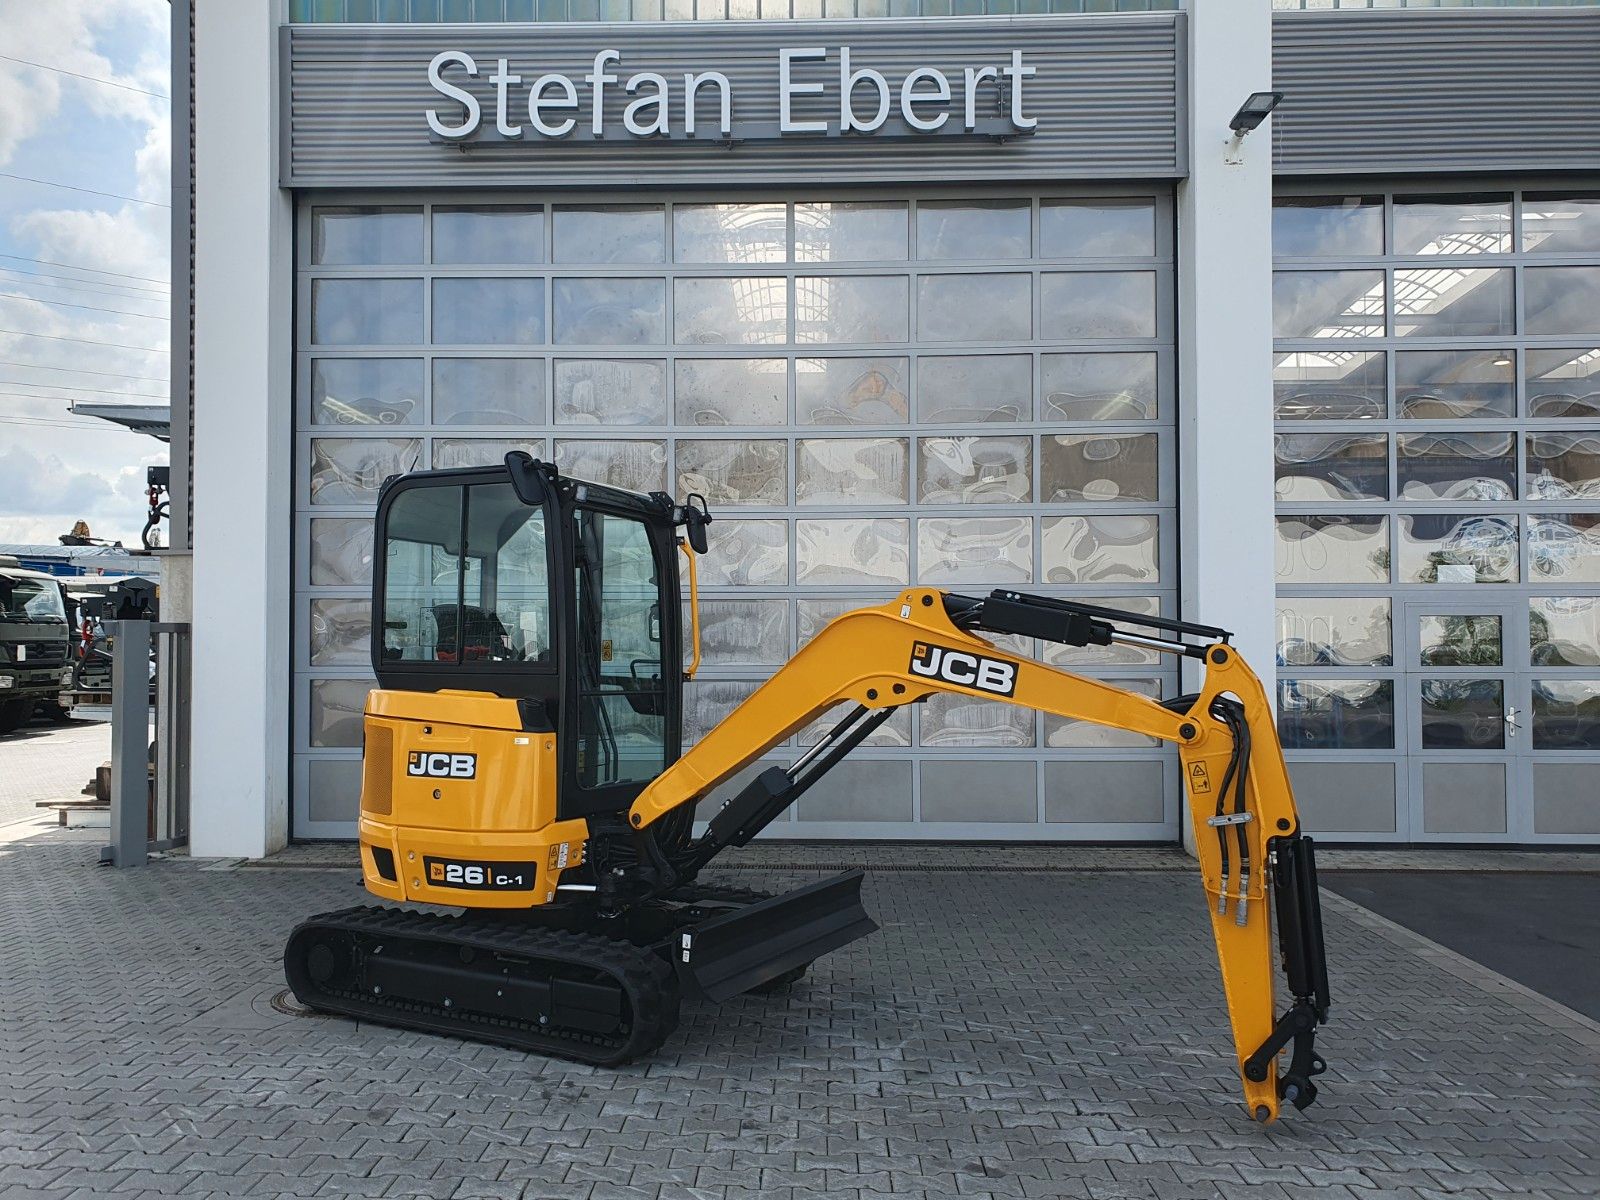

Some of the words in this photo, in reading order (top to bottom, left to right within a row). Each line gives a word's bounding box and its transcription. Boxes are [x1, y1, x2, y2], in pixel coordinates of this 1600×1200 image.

[425, 49, 732, 139] Stefan
[779, 46, 1038, 136] Ebert
[912, 648, 1014, 693] JCB
[409, 753, 475, 777] JCB
[446, 864, 483, 885] 26
[496, 875, 523, 885] C-1
